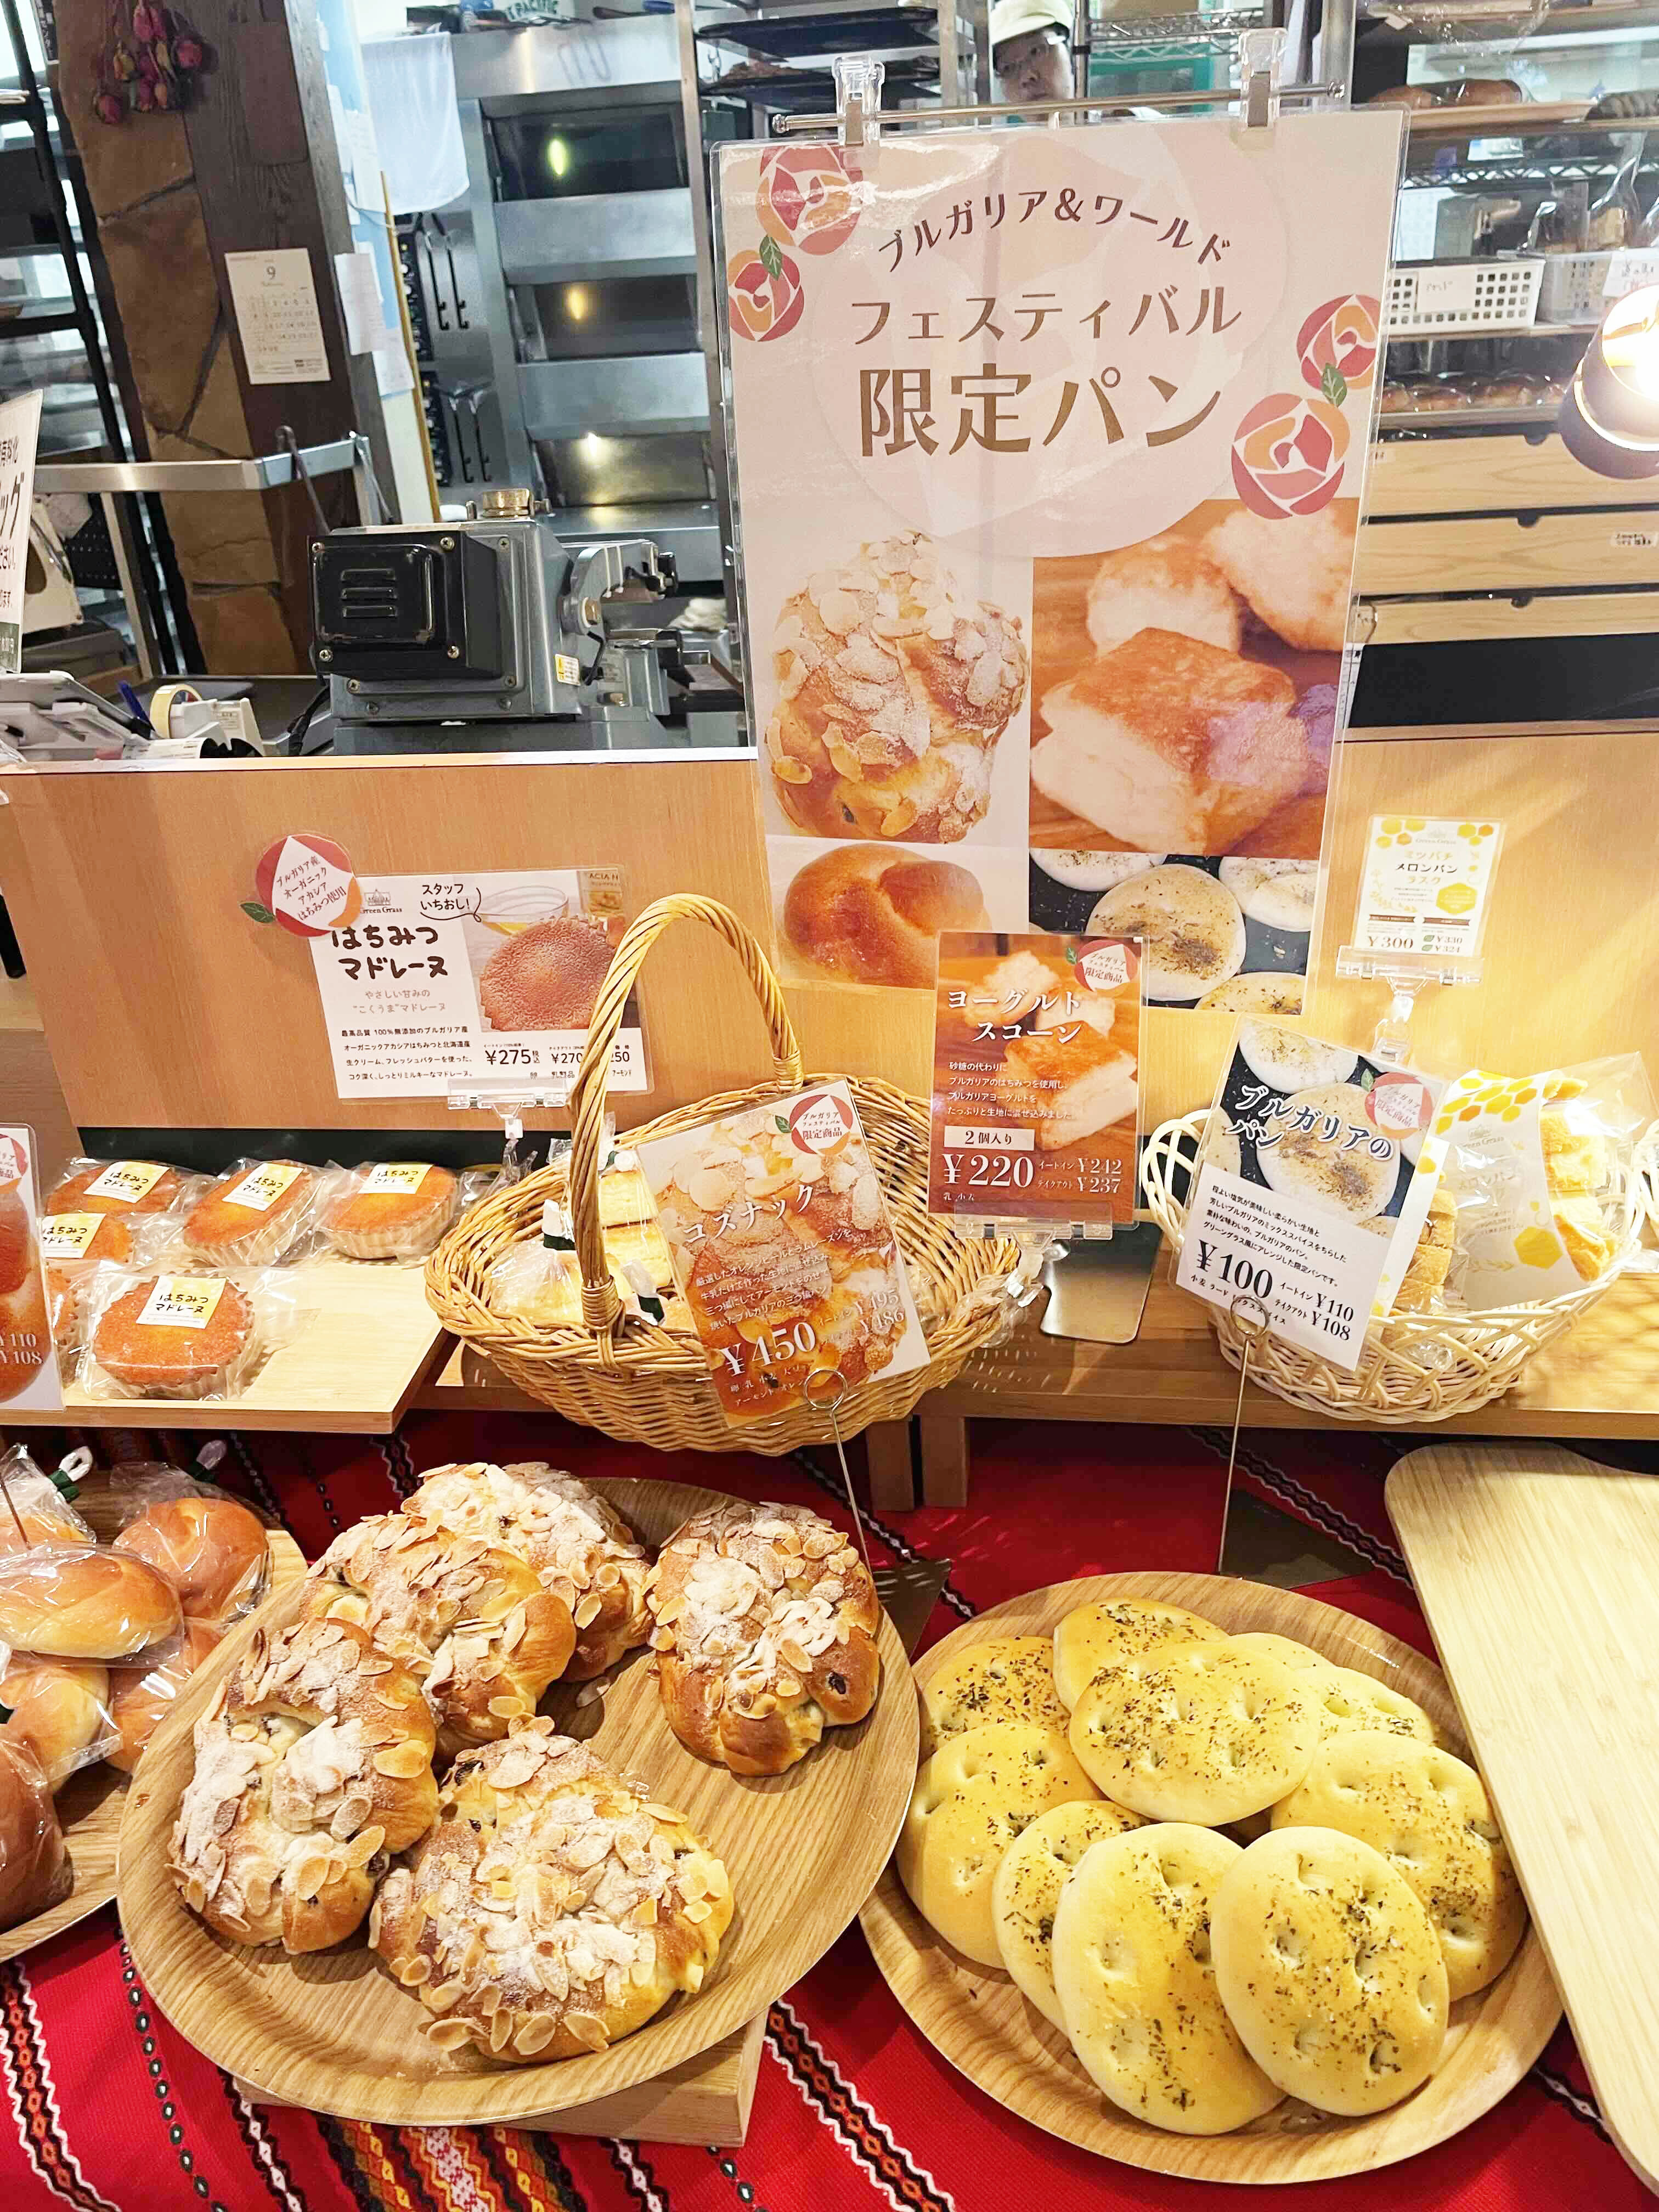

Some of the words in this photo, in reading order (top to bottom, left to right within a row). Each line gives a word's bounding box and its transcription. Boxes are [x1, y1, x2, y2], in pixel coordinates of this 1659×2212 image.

[878, 188, 1231, 273] ブルガリア&ワールド
[851, 286, 1242, 345] フェスティバル
[860, 363, 1222, 457] 限定パン
[1396, 864, 1457, 873] メロンパン
[284, 867, 326, 899] オーガニック
[298, 882, 326, 905] アカシア
[422, 883, 464, 895] スタッフ
[298, 887, 346, 920] はちみつ使用
[332, 924, 438, 950] はちみつ
[338, 956, 448, 980] マドレーヌ
[1086, 967, 1122, 983] 限定商品
[365, 989, 430, 1000] やさしい甘みの
[948, 989, 1080, 1015] ヨーグルト
[972, 1022, 1082, 1045] スコーン
[485, 1049, 531, 1065] ¥275
[950, 1062, 1007, 1071] 砂糖の代わりに
[948, 1092, 1036, 1103] ブルガリアヨーグルトを
[803, 1111, 839, 1120] ブルガリア
[1235, 1085, 1393, 1160] ブルガリアの
[803, 1127, 842, 1139] 限定商品
[1225, 1119, 1284, 1149] パン
[110, 1171, 149, 1184] はちみつ
[942, 1154, 1034, 1188] ¥220
[1040, 1160, 1075, 1170] イートイン
[1077, 1158, 1122, 1174] ¥242
[104, 1179, 142, 1191] マドレーヌ
[251, 1177, 283, 1188] はちみつ
[1037, 1180, 1073, 1189] テイクアウト
[1077, 1177, 1121, 1194] ¥237
[685, 1184, 813, 1243] コズナック
[1203, 1221, 1338, 1286] グリーングラス風にアレンジした限定パンです。
[1196, 1239, 1273, 1298] ¥100
[156, 1304, 204, 1313] マドレーヌ
[159, 1293, 208, 1304] はちみつ
[1280, 1282, 1313, 1300] イートイン
[1317, 1293, 1353, 1322] ¥110
[1274, 1299, 1307, 1318] テイクアウト
[1311, 1311, 1350, 1340] ¥108
[720, 1322, 816, 1377] ¥450
